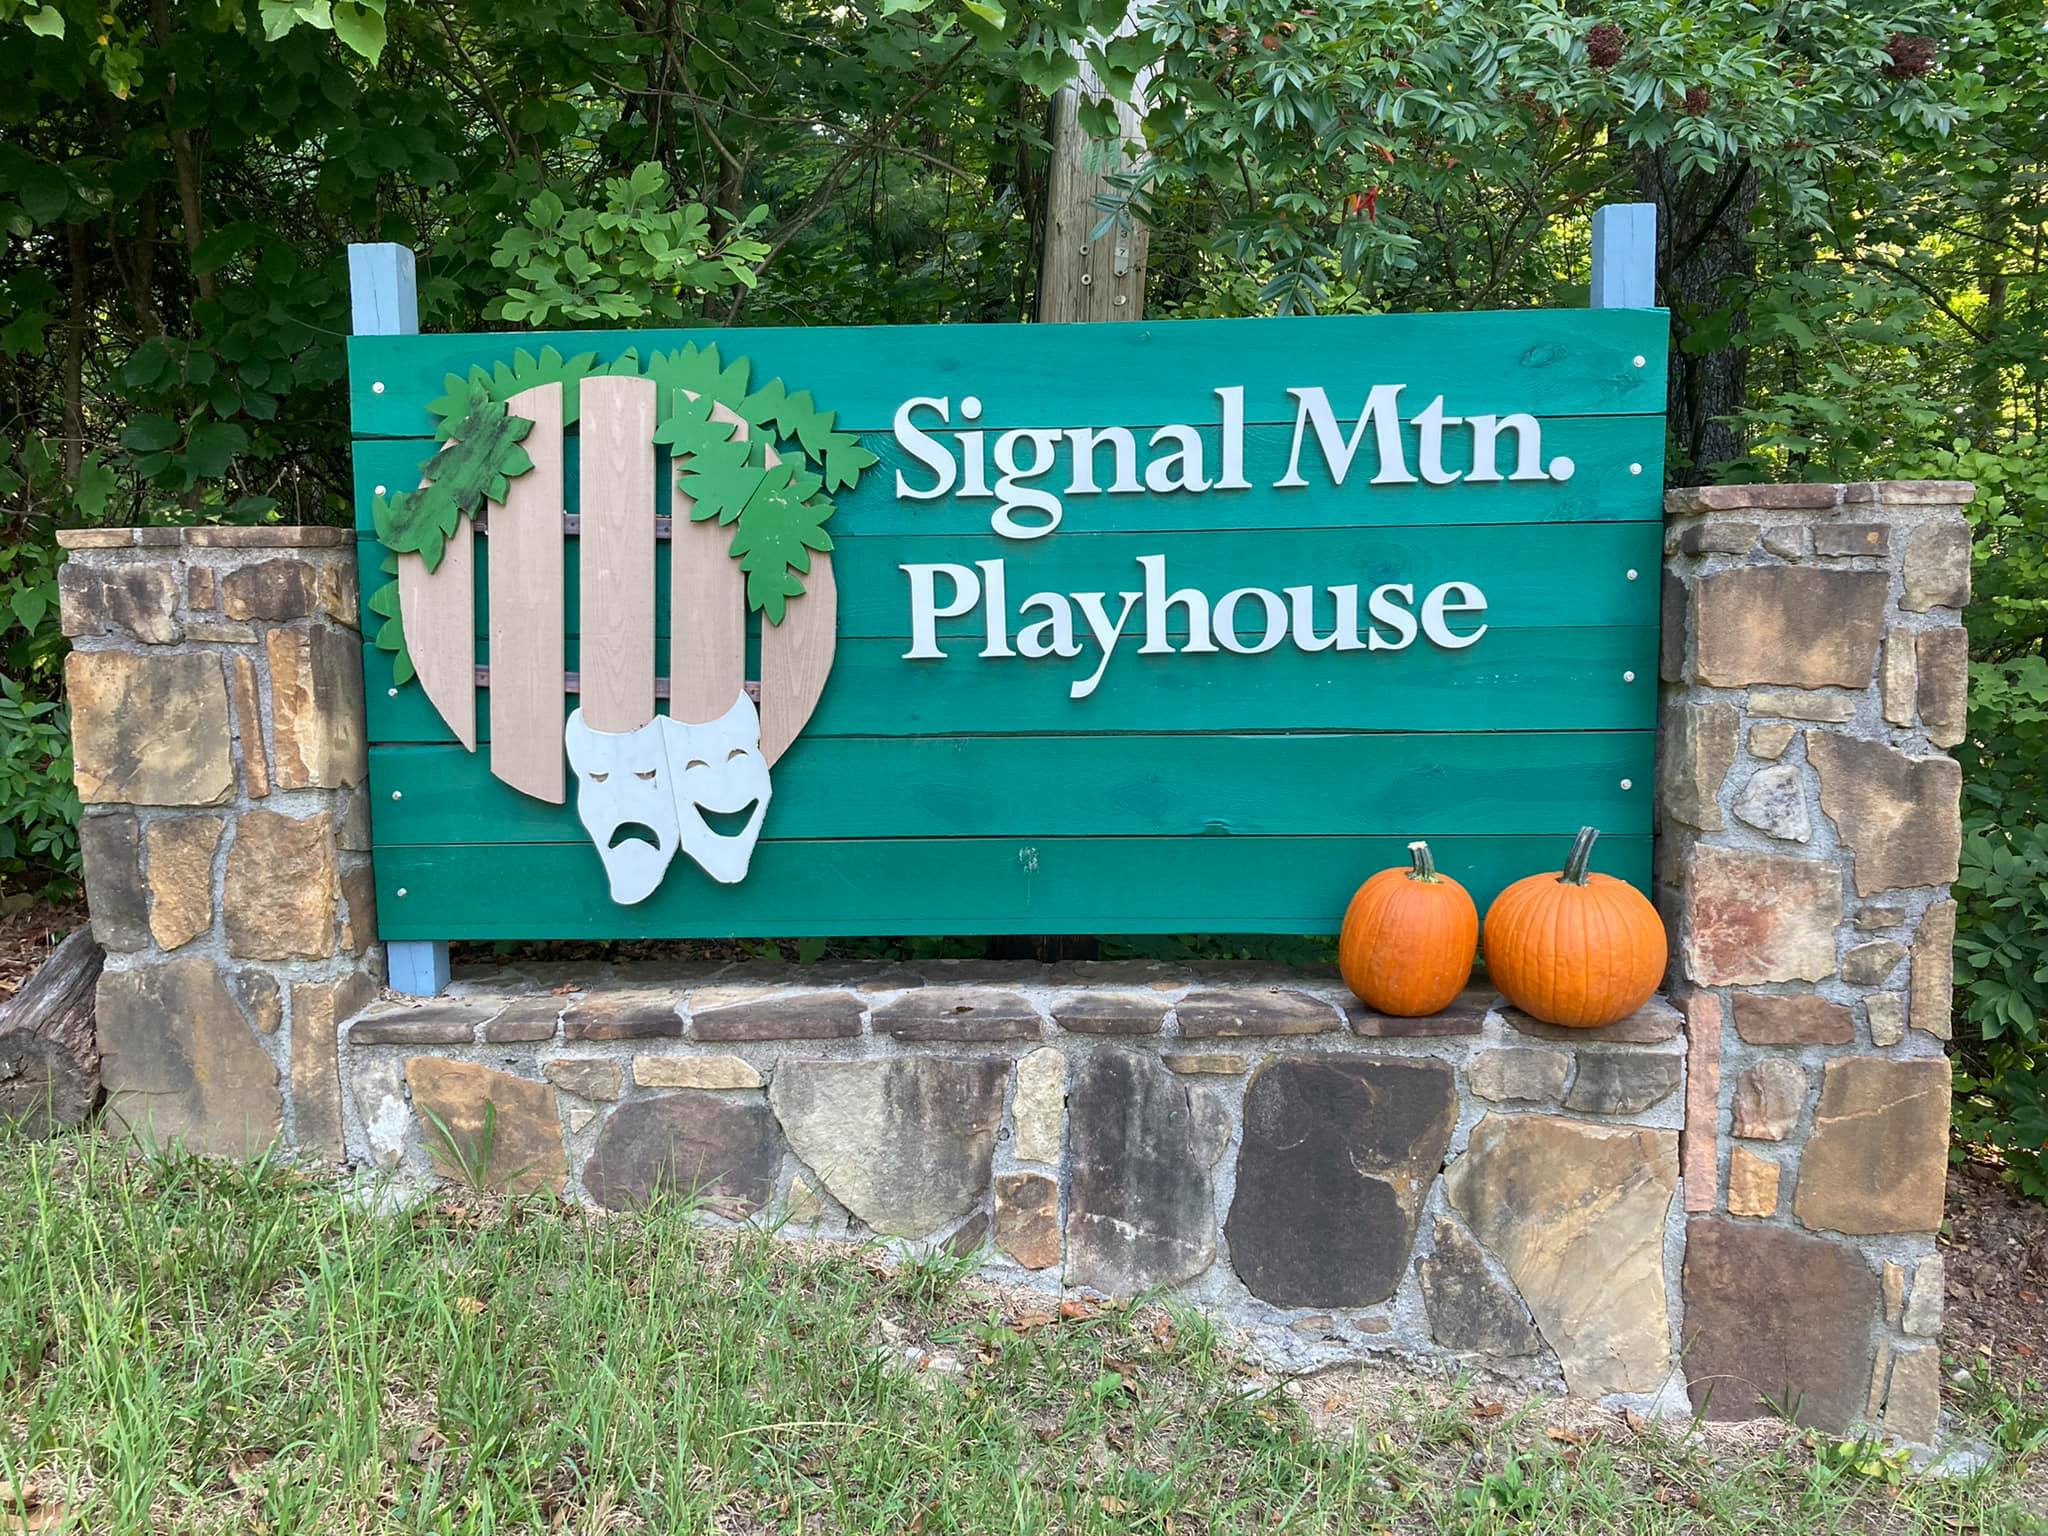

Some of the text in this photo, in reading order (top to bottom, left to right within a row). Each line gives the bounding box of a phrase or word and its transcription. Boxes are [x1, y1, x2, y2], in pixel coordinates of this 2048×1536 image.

[893, 383, 1575, 539] Signal Mtn.
[899, 554, 1489, 700] Playhouse
